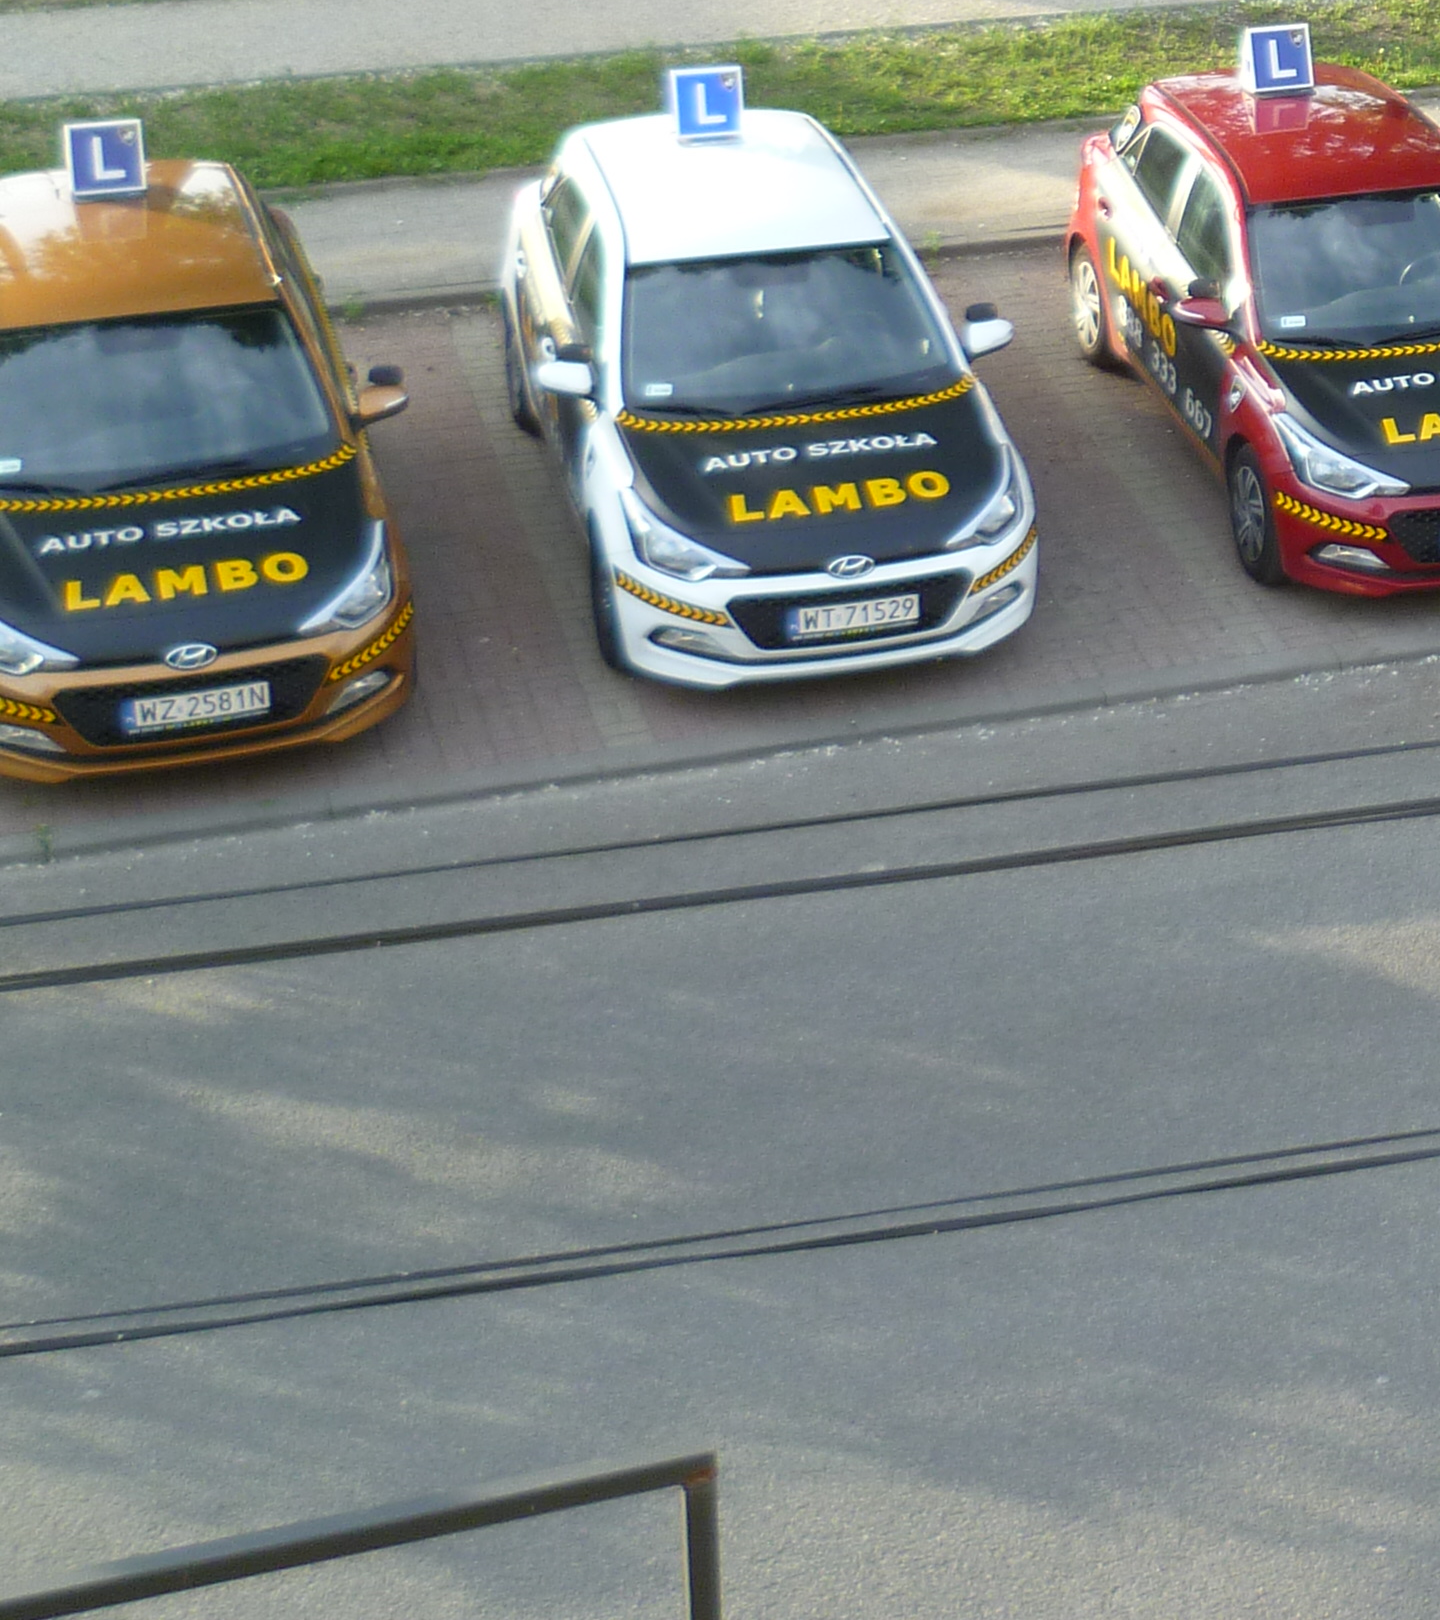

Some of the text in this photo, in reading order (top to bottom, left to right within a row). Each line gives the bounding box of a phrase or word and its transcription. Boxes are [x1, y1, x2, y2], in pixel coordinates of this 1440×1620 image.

[1268, 39, 1298, 79] L
[695, 82, 727, 125] L
[91, 136, 127, 180] L
[1107, 236, 1177, 357] LAMBO
[1150, 340, 1177, 395] 333
[1184, 388, 1212, 440] 667
[1352, 372, 1435, 395] AUTO
[704, 433, 938, 472] AUTO SZKOŁA
[729, 470, 950, 523] LAMBO
[39, 507, 302, 554] AUTO SZKOŁA
[64, 551, 309, 611] LAMBO
[803, 608, 838, 631] WT
[844, 597, 916, 627] 71529
[138, 699, 179, 724] WZ
[186, 685, 267, 718] 2581N
